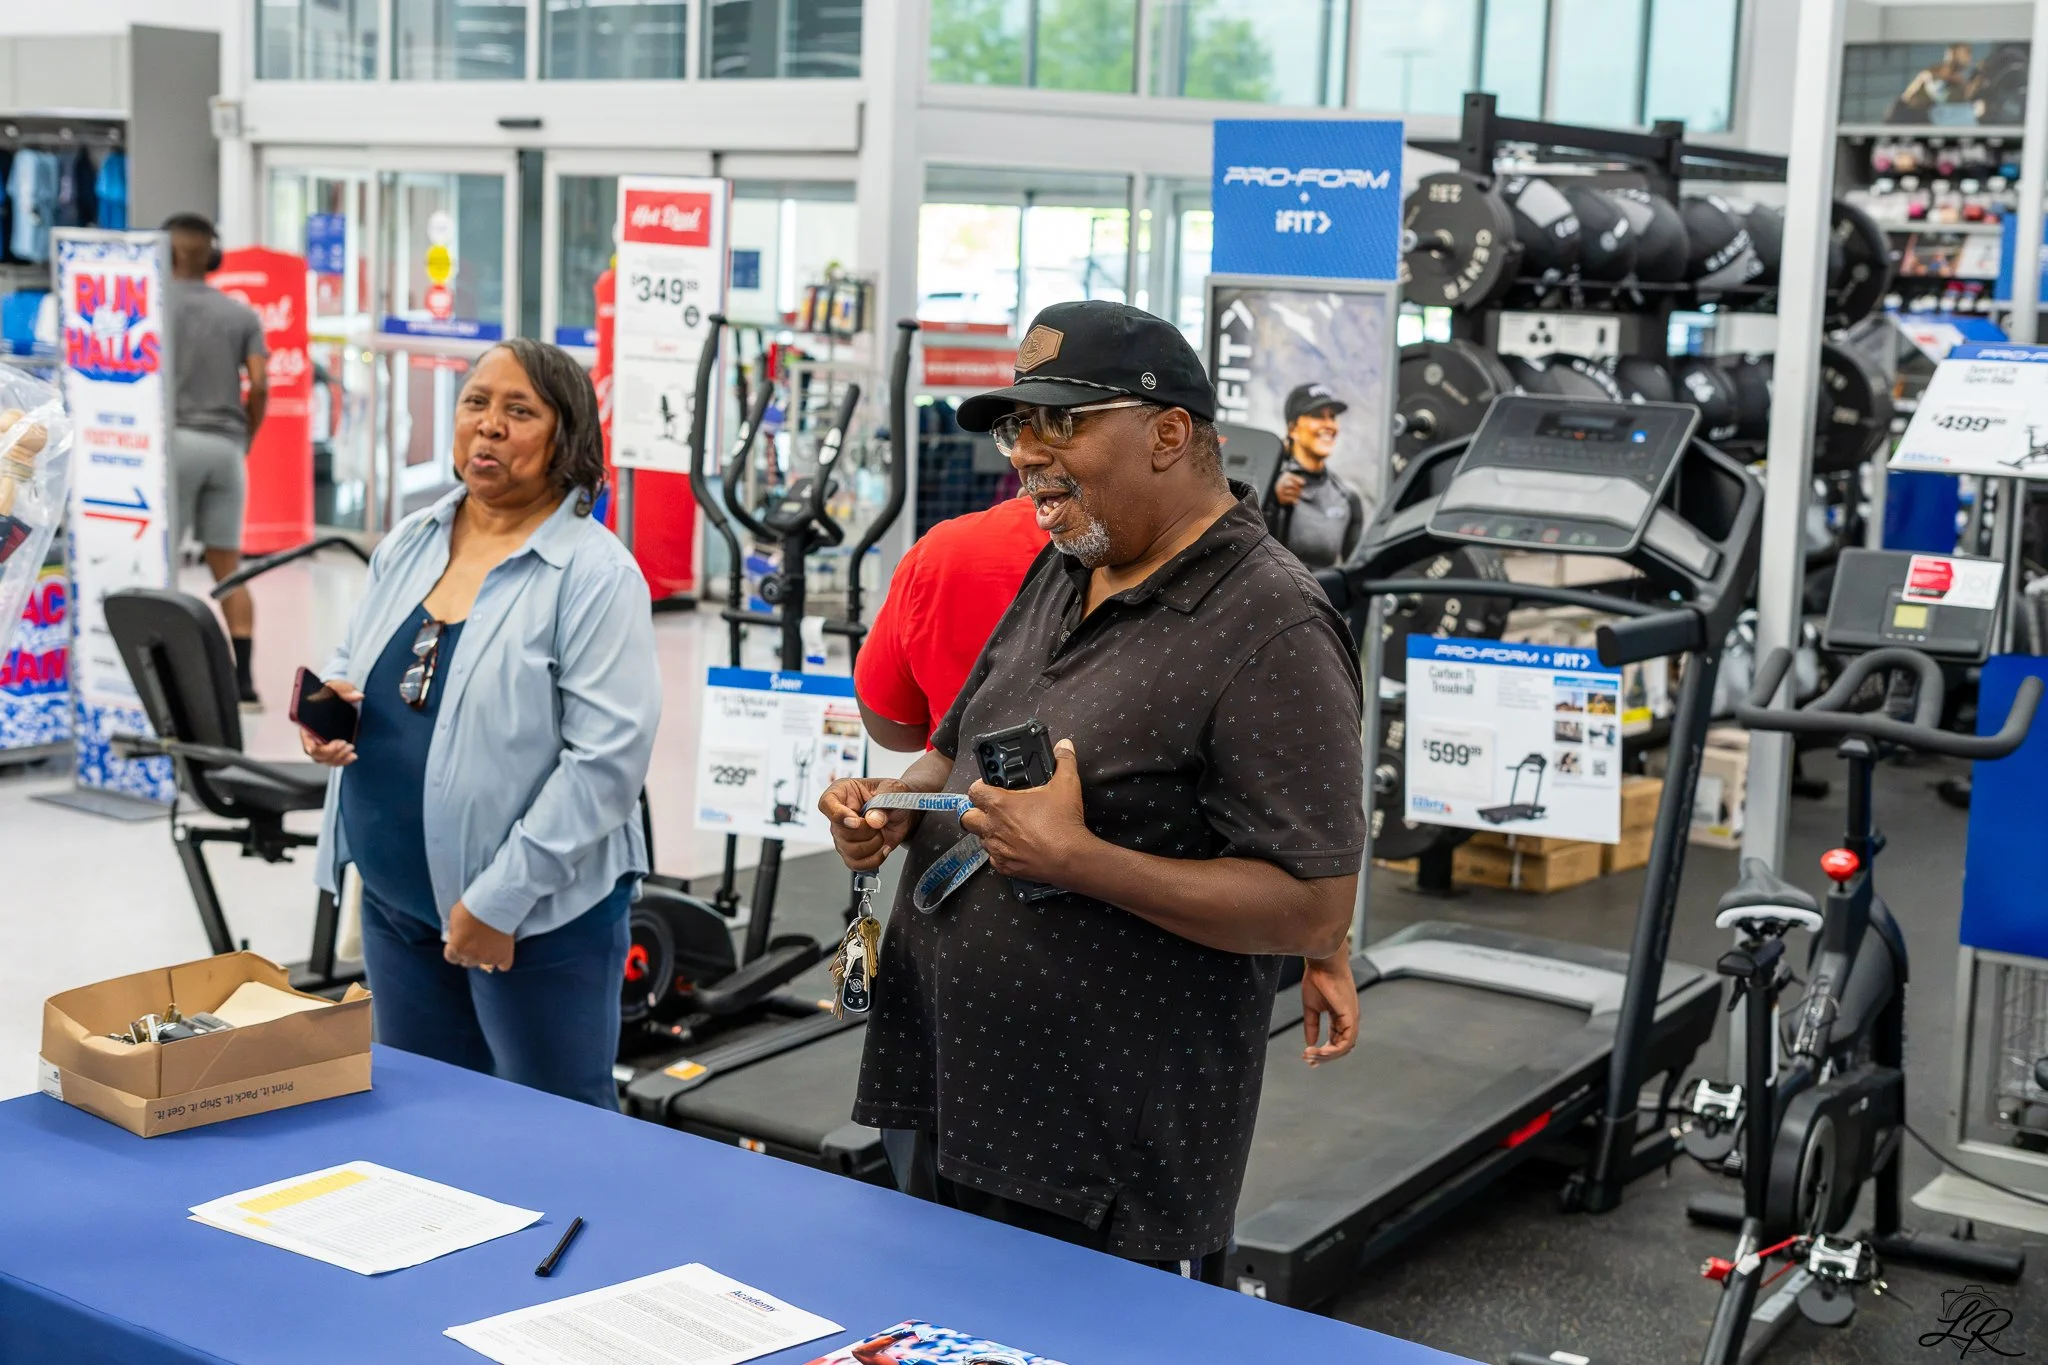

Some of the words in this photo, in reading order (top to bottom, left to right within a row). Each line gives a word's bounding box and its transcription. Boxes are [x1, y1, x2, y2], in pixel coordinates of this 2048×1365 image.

[1223, 166, 1390, 189] PRO-FORM
[74, 272, 148, 318] RUN
[64, 327, 161, 374] HALLS
[1435, 644, 1539, 664] PRO-FORM
[918, 798, 962, 810] EMPHIS
[260, 1087, 270, 1096] it.
[271, 1081, 294, 1093] Print
[224, 1095, 234, 1104] it.
[235, 1091, 258, 1102] Pack
[188, 1103, 198, 1112] it.
[200, 1098, 222, 1109] Ship
[154, 1110, 165, 1120] it.
[167, 1105, 186, 1117] Get
[730, 1290, 776, 1312] Academy
